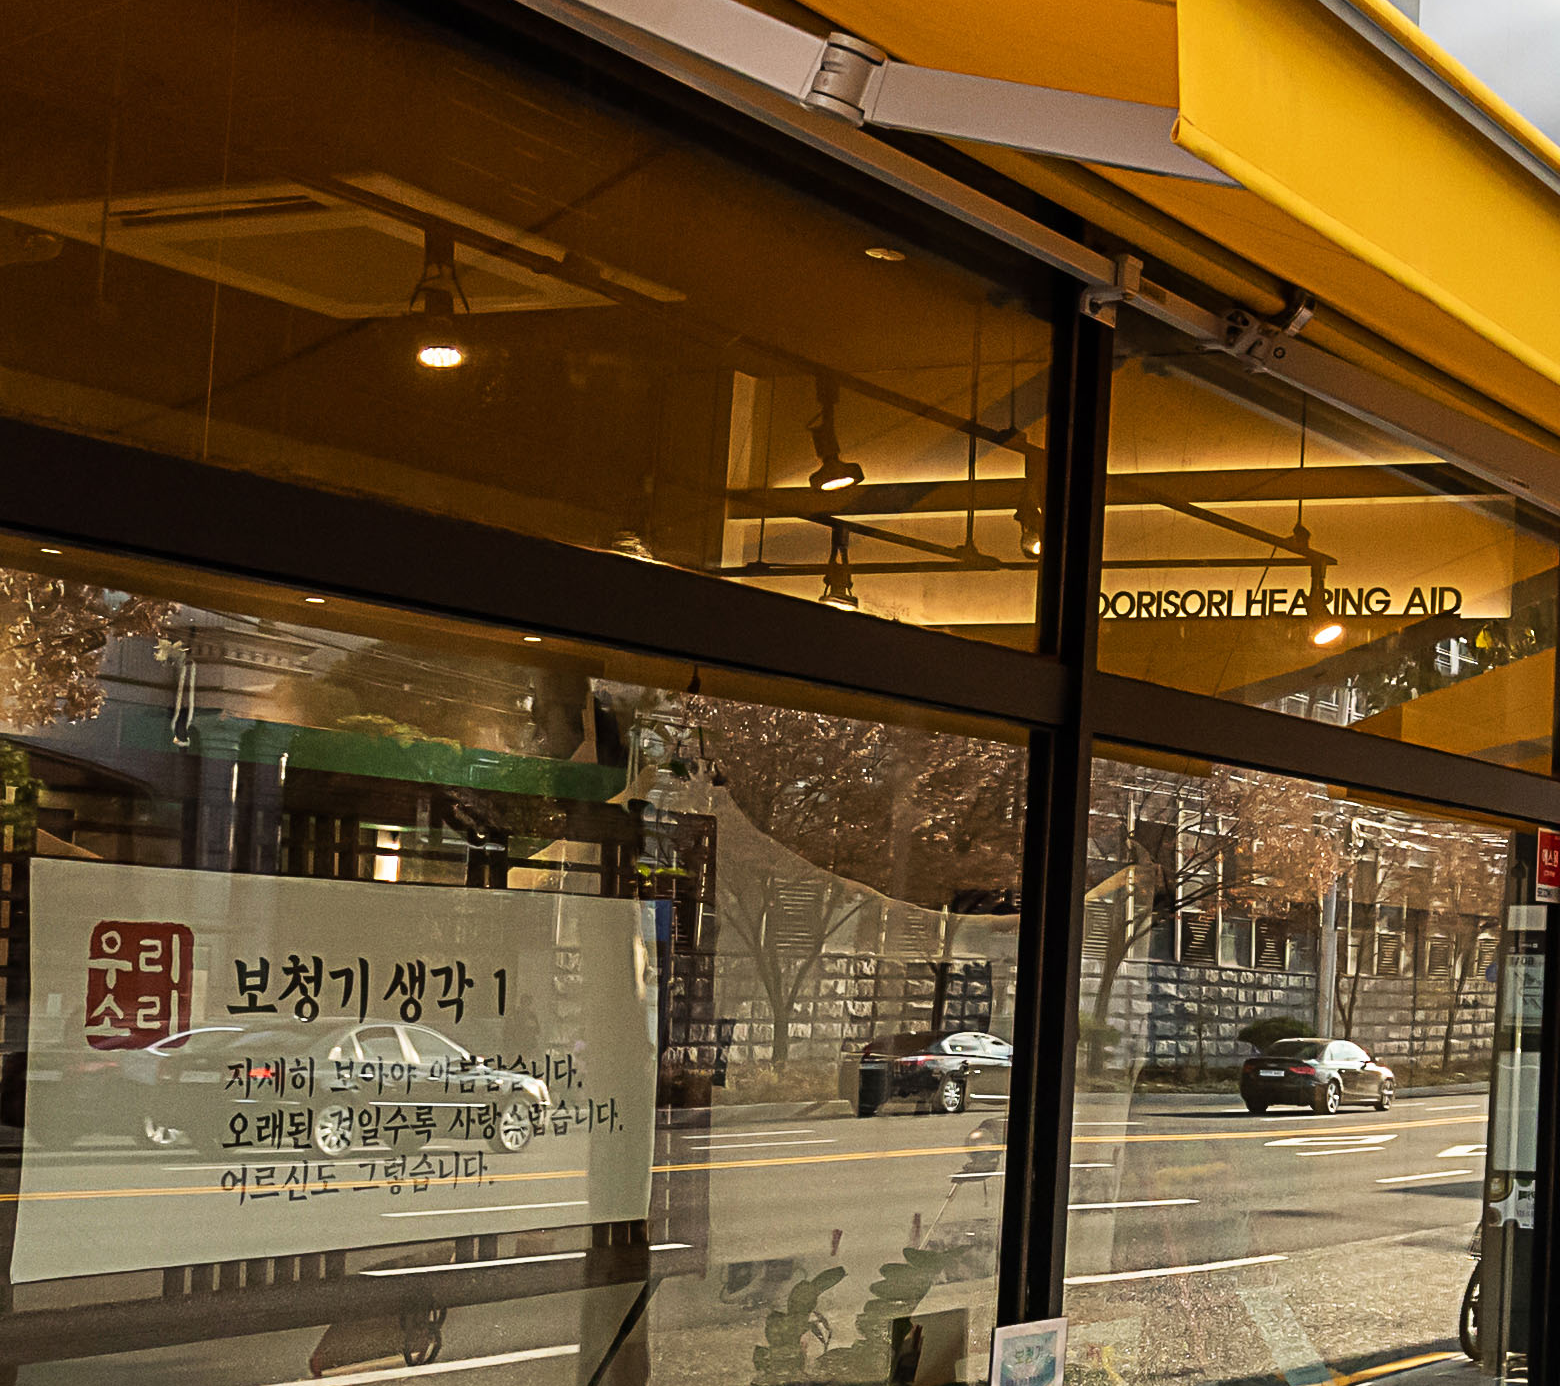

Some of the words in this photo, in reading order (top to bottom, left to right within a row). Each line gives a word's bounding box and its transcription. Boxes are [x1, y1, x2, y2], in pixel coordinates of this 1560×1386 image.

[1405, 585, 1462, 616] AID
[87, 929, 181, 989] 우리
[226, 955, 370, 1024] 보청기
[384, 959, 474, 1024] 생각
[494, 966, 507, 1016] 1
[84, 990, 180, 1037] 소리
[225, 1056, 316, 1098] 자세히
[330, 1057, 417, 1094] 보아야
[221, 1111, 314, 1150] 오래된
[316, 1104, 438, 1146] 것일수록
[220, 1158, 343, 1206] 어르신도
[351, 1150, 495, 1196] 그렇습니다.
